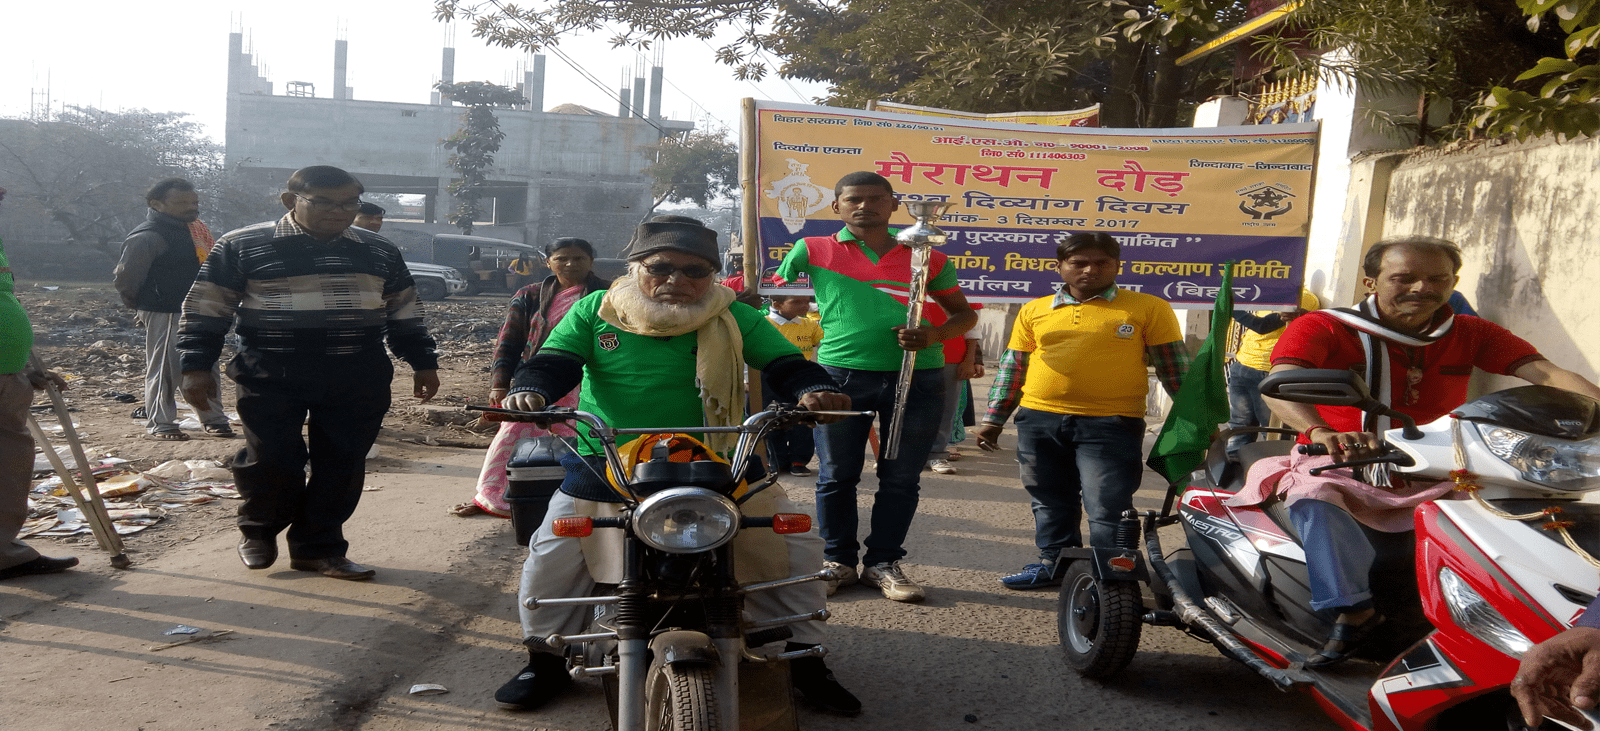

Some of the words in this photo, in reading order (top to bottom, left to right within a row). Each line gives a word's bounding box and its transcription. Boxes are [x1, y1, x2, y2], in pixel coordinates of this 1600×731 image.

[807, 116, 848, 126] सरकार
[773, 141, 819, 153] दिव्यांग
[822, 146, 862, 155] एकता
[1029, 152, 1086, 160] 111406303
[1189, 159, 1245, 169] जिन्दाबाद
[874, 151, 1058, 190] मैराथन
[1096, 160, 1190, 197] दौड़
[962, 190, 1085, 212] दिव्यांग
[1095, 195, 1191, 215] दिवस
[997, 216, 1008, 224] 3
[1016, 212, 1088, 227] दिसम्बर
[1095, 218, 1140, 229] 2017
[965, 230, 1050, 245] पुरस्कार
[1131, 260, 1213, 277] कल्याण
[1120, 325, 1133, 333] 23
[1180, 510, 1243, 540] MAESTRO
